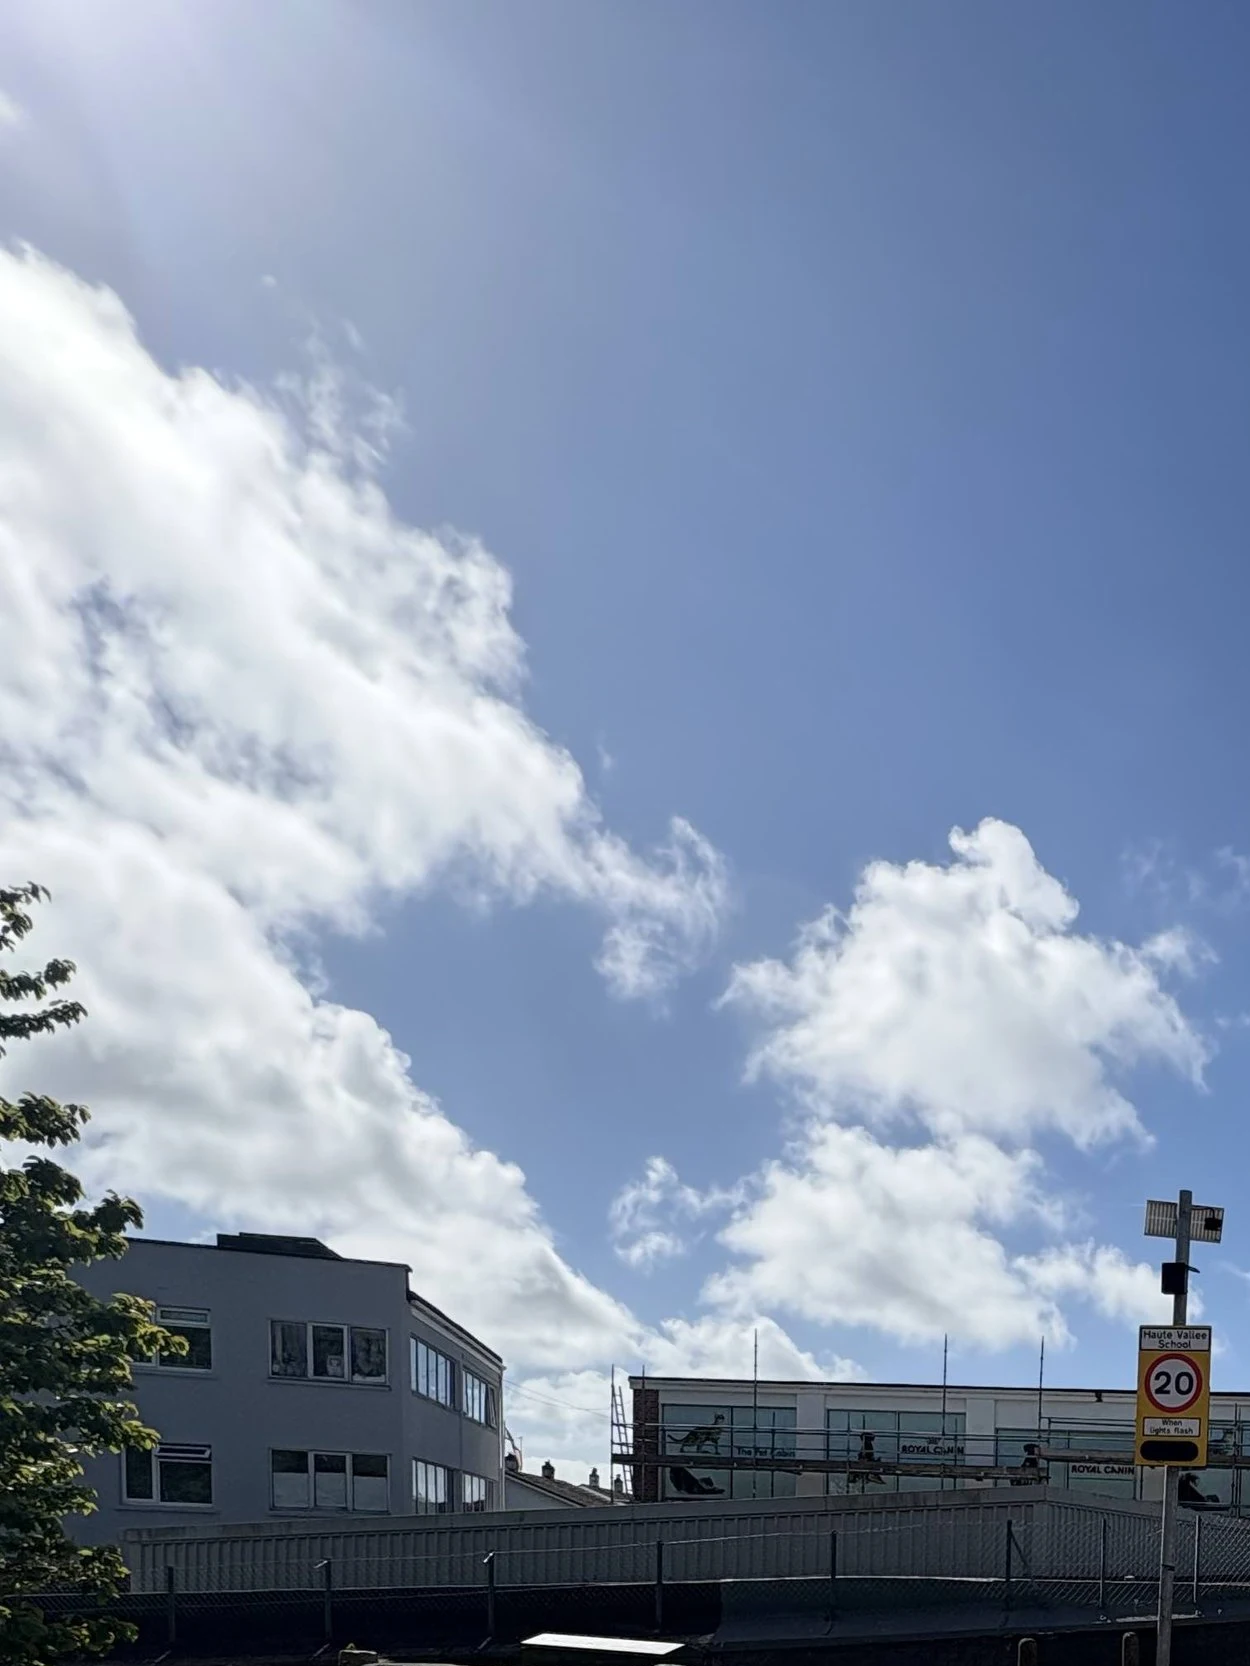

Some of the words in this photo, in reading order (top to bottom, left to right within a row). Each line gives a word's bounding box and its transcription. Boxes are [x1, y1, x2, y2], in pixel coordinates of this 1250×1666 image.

[1143, 1330, 1173, 1339] Haute
[1176, 1331, 1207, 1340] Vallee
[1158, 1340, 1191, 1349] School
[1154, 1371, 1194, 1395] 20
[901, 1445, 931, 1454] ROYAL
[933, 1446, 965, 1455] CANN
[1071, 1465, 1102, 1474] ROYAL
[1104, 1466, 1135, 1475] CANIN
